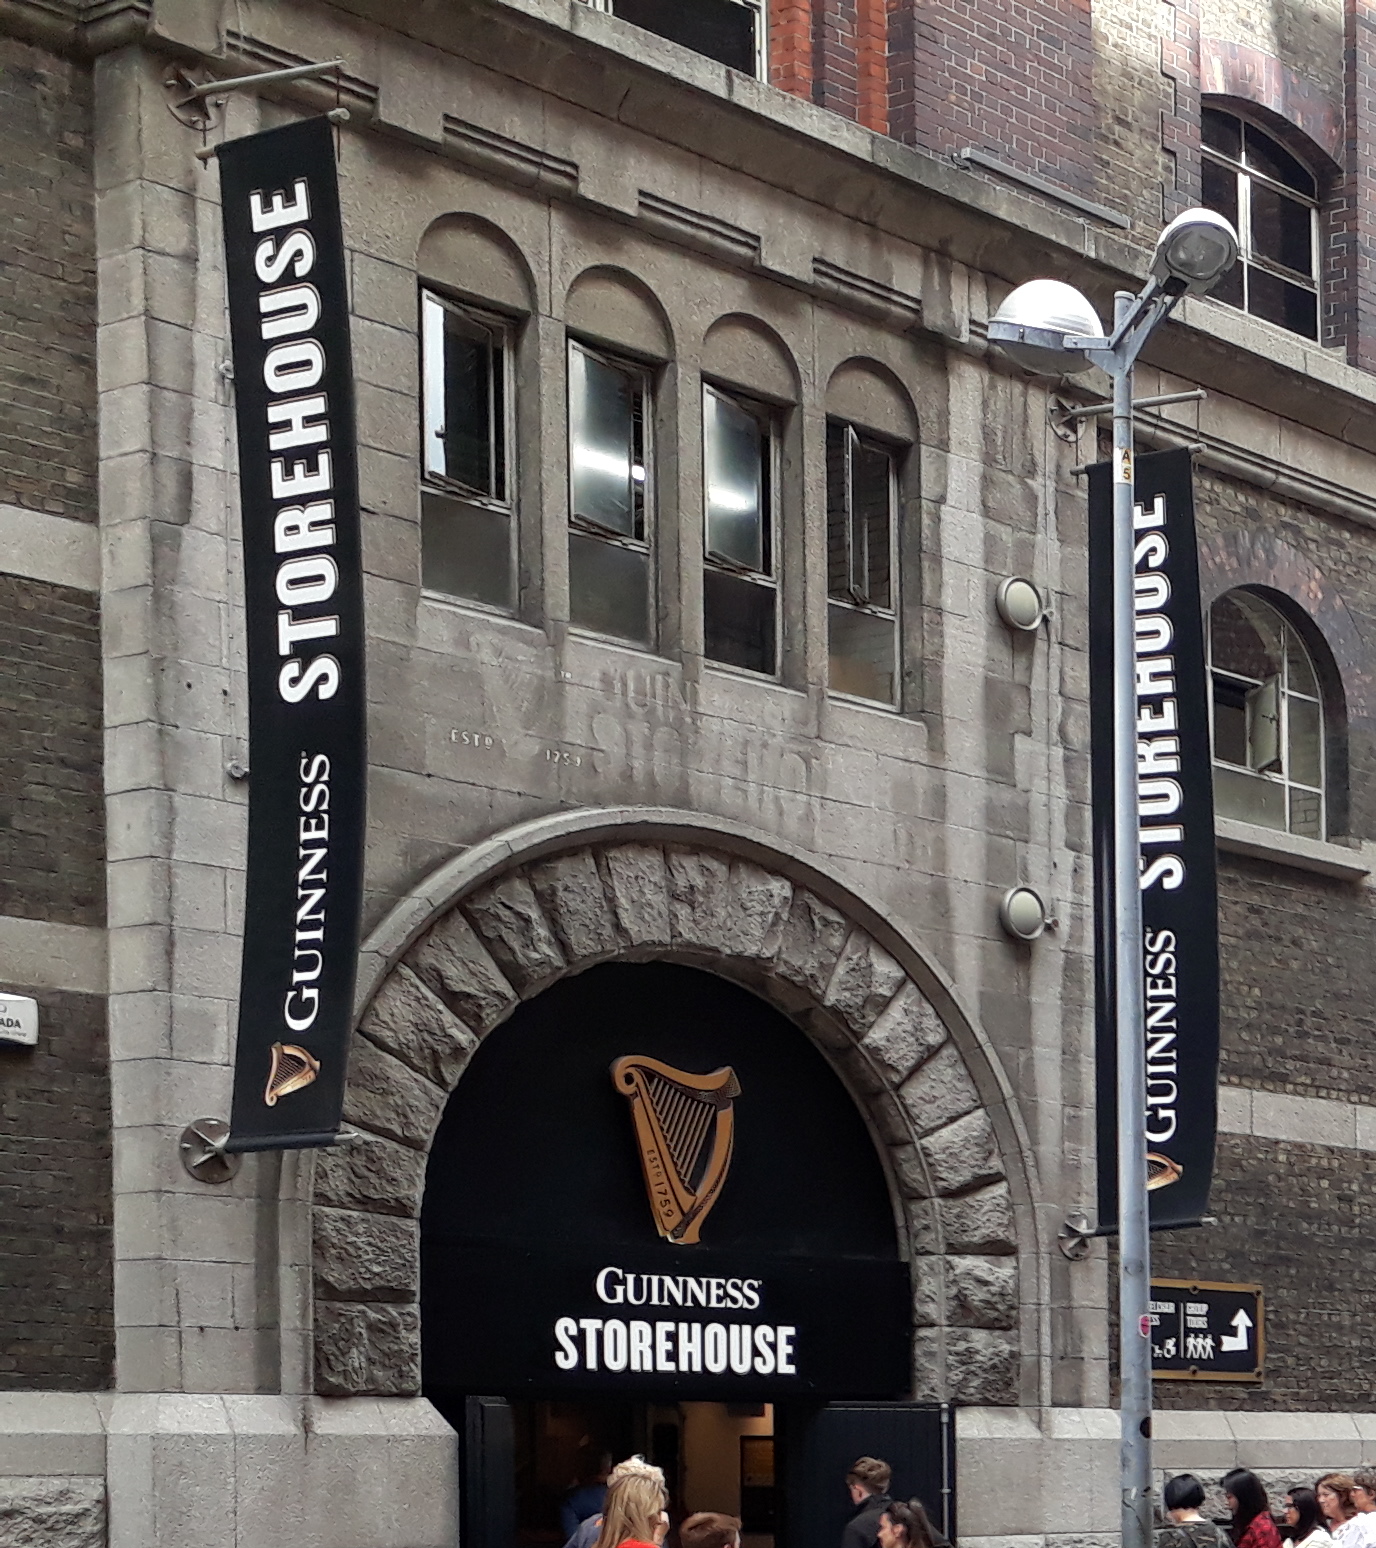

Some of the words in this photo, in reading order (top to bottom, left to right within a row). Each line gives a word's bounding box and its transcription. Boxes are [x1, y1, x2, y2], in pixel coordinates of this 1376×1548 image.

[250, 178, 341, 702] STOREHOUSE
[284, 753, 331, 1031] GUINNESS
[1144, 930, 1178, 1142] GUINNESS
[653, 1181, 674, 1218] 1759
[554, 1316, 797, 1376] STOREHOUSE
[596, 1266, 760, 1310] GUINNESS
